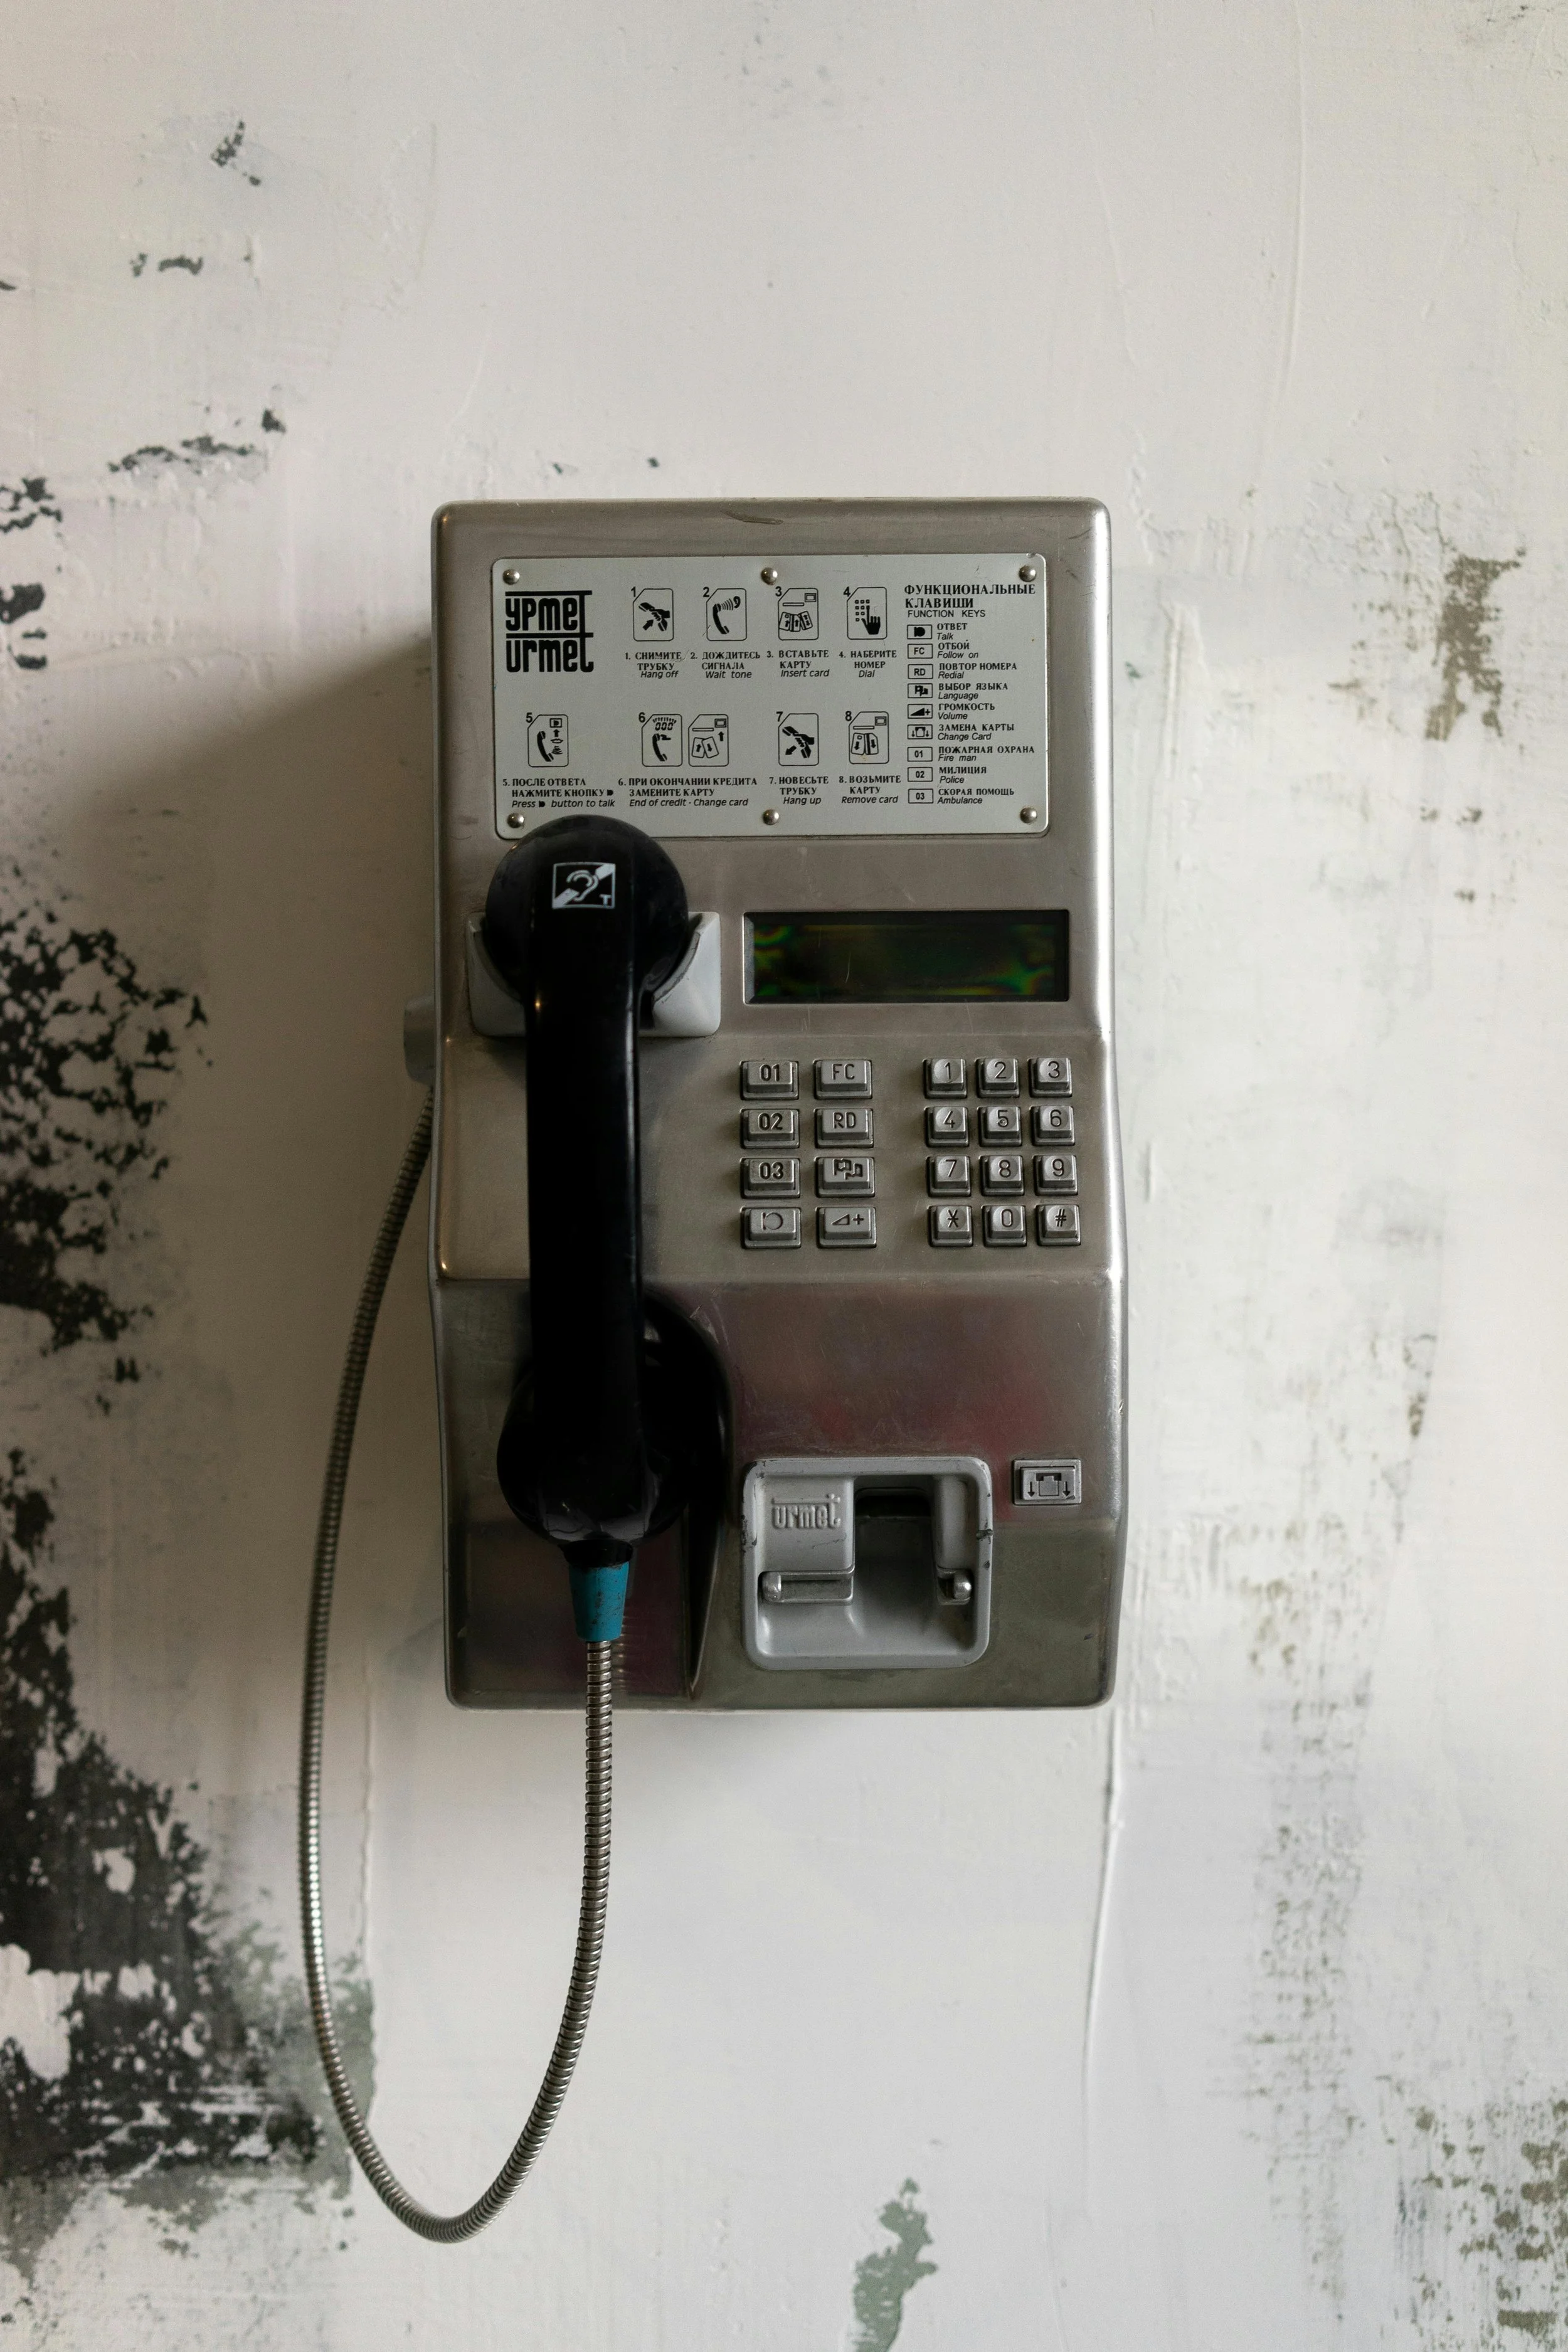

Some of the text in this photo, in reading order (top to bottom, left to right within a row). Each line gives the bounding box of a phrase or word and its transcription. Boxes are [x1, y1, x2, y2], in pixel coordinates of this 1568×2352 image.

[631, 587, 636, 597] 1
[703, 587, 709, 597] 2
[775, 586, 782, 596] 3
[843, 587, 850, 596] 4
[904, 585, 1036, 596] ФУНКЦИОНАЛЬНЫЕ
[906, 598, 973, 608] КЛАВИШИ
[908, 610, 954, 618] FUNCTION
[938, 641, 970, 650] ОТБОЙ
[635, 652, 682, 660] СНИМИТЕ
[702, 652, 760, 660] ДОЖДИТЕСЬ
[779, 650, 829, 658] ВСТАВЬТЕ
[706, 670, 726, 679] Wait
[914, 668, 925, 676] RD
[938, 692, 978, 701] Language
[526, 712, 532, 723] 5
[638, 712, 645, 723] 6
[776, 711, 783, 722] 7
[845, 711, 852, 722] 8
[938, 733, 969, 741] Change
[939, 746, 993, 755] ПОЖАРНАЯ
[938, 753, 954, 761] Fire
[512, 778, 545, 787] ПОСЛЕ
[650, 778, 710, 786] ОКОНЧАНИИ
[713, 778, 757, 786] КРЕДИТА
[849, 775, 901, 783] ВОЗЬМИТЕ
[512, 789, 562, 797] НАЖМИТЕ
[630, 788, 681, 797] ЗАМЕНИТЕ
[938, 787, 972, 795] СКОРАЯ
[694, 798, 727, 807] Change
[783, 797, 807, 805] Hang
[600, 894, 612, 908] T
[760, 1064, 780, 1081] 01
[832, 1063, 854, 1080] FC
[944, 1061, 951, 1080] 1
[993, 1061, 1007, 1079] 2
[1047, 1061, 1060, 1079] 3
[759, 1113, 783, 1130] 02
[834, 1112, 856, 1129] RD
[943, 1110, 955, 1128] 4
[997, 1110, 1009, 1127] 5
[1050, 1109, 1062, 1127] 6
[760, 1162, 783, 1179] 03
[945, 1159, 957, 1177] 7
[999, 1159, 1011, 1178] 8
[1052, 1158, 1064, 1177] 9
[1001, 1209, 1012, 1227] 0
[772, 1493, 841, 1529] urmet
